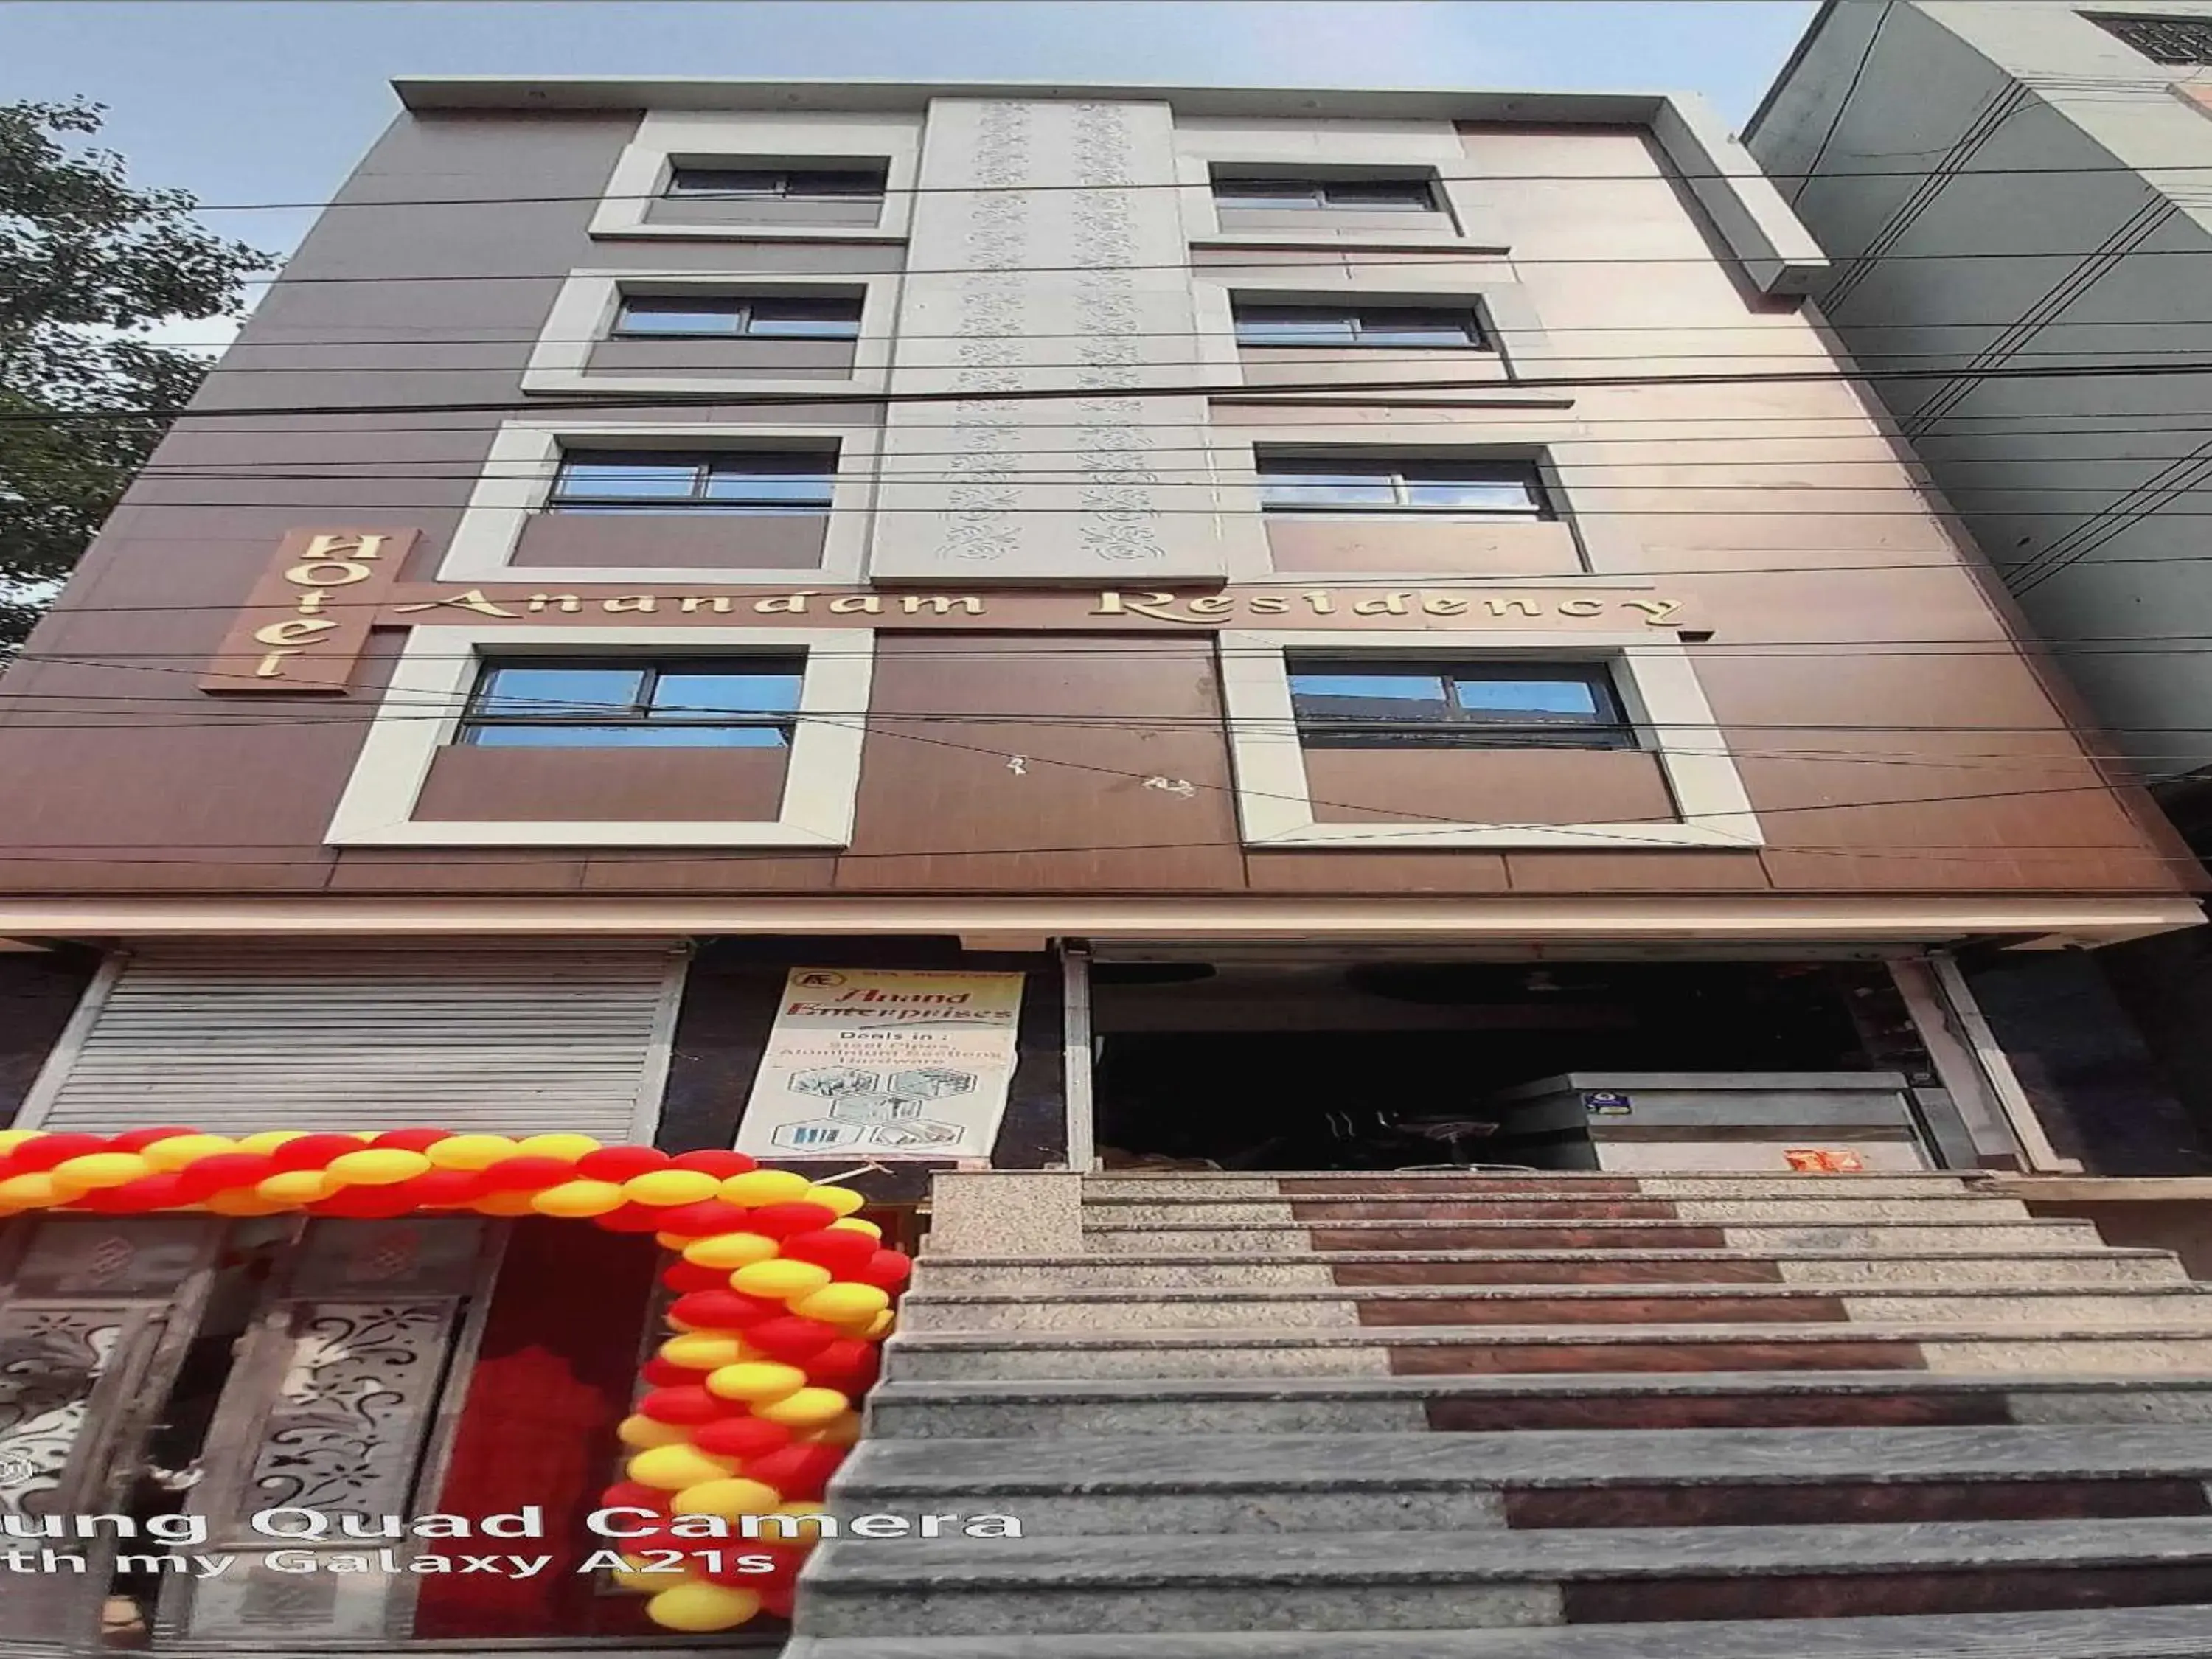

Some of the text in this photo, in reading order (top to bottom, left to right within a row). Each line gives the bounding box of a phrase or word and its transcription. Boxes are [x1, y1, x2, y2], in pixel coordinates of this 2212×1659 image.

[254, 535, 392, 677] Hotel
[394, 589, 1684, 626] Anandam Residency
[834, 988, 972, 1004] Anand
[785, 1002, 1012, 1020] Enterprises
[840, 1031, 903, 1040] Deals
